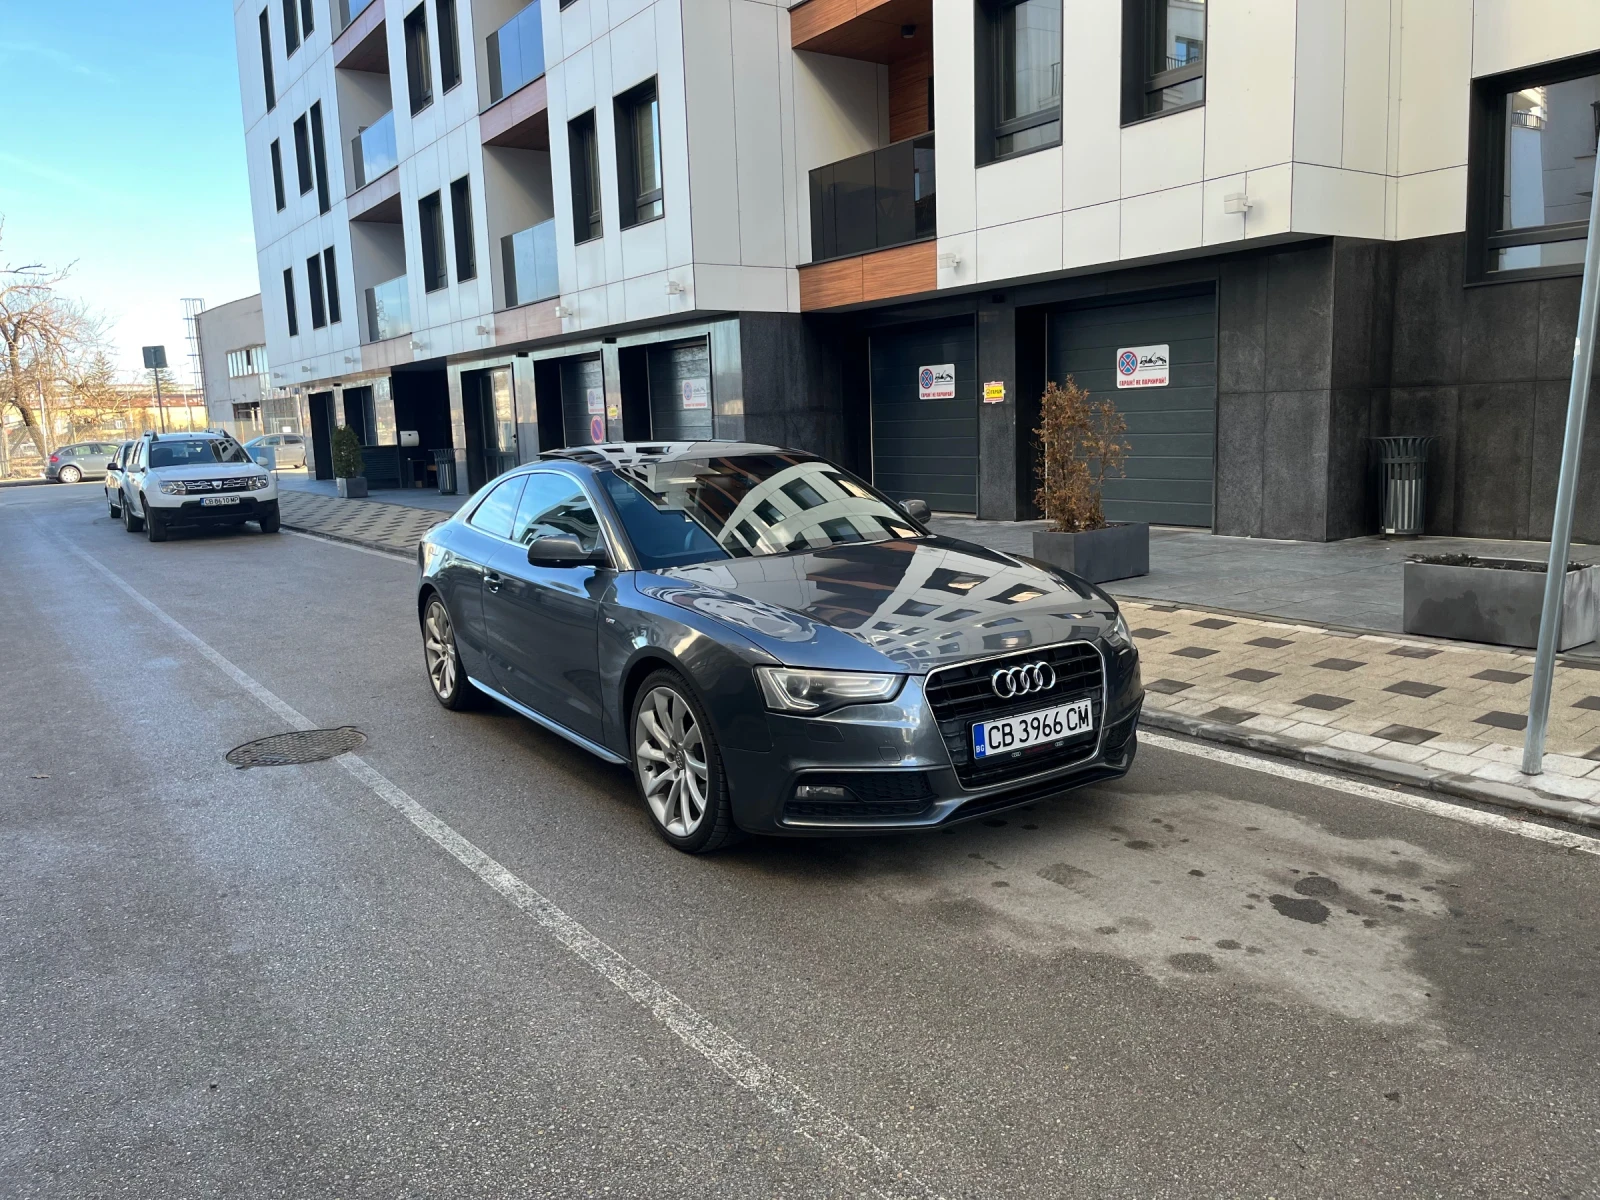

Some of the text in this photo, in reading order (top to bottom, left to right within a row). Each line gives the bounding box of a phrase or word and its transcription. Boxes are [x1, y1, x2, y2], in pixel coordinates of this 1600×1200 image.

[988, 704, 1090, 750] CB 3966 CM
[976, 744, 985, 754] BG
